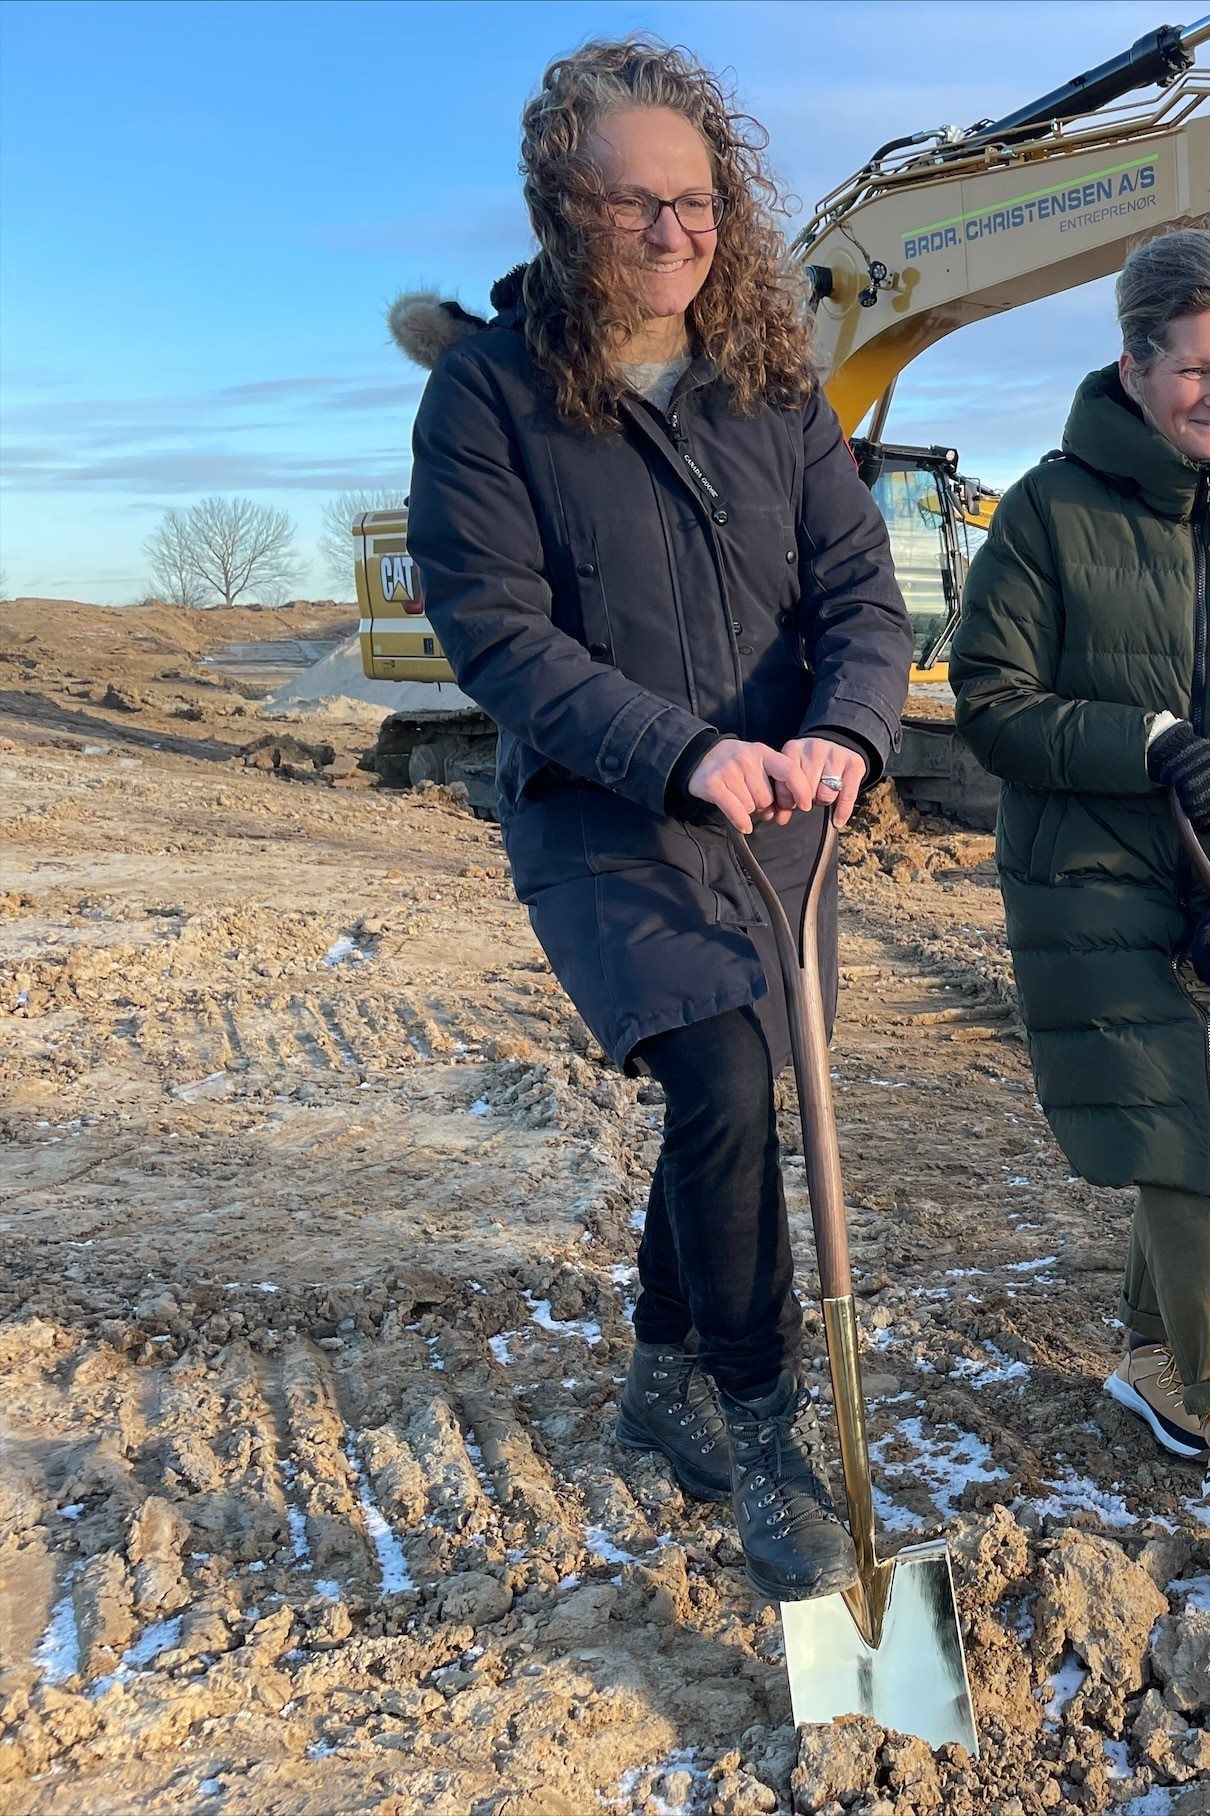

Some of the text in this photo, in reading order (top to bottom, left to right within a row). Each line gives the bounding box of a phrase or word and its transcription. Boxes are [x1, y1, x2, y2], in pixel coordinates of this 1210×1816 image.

[904, 165, 1155, 260] BRDR. CHRISTENSEN A/S
[1060, 194, 1157, 233] ENTREPRENØR
[684, 454, 719, 497] CANADA GOOSE
[380, 555, 414, 602] CAT
